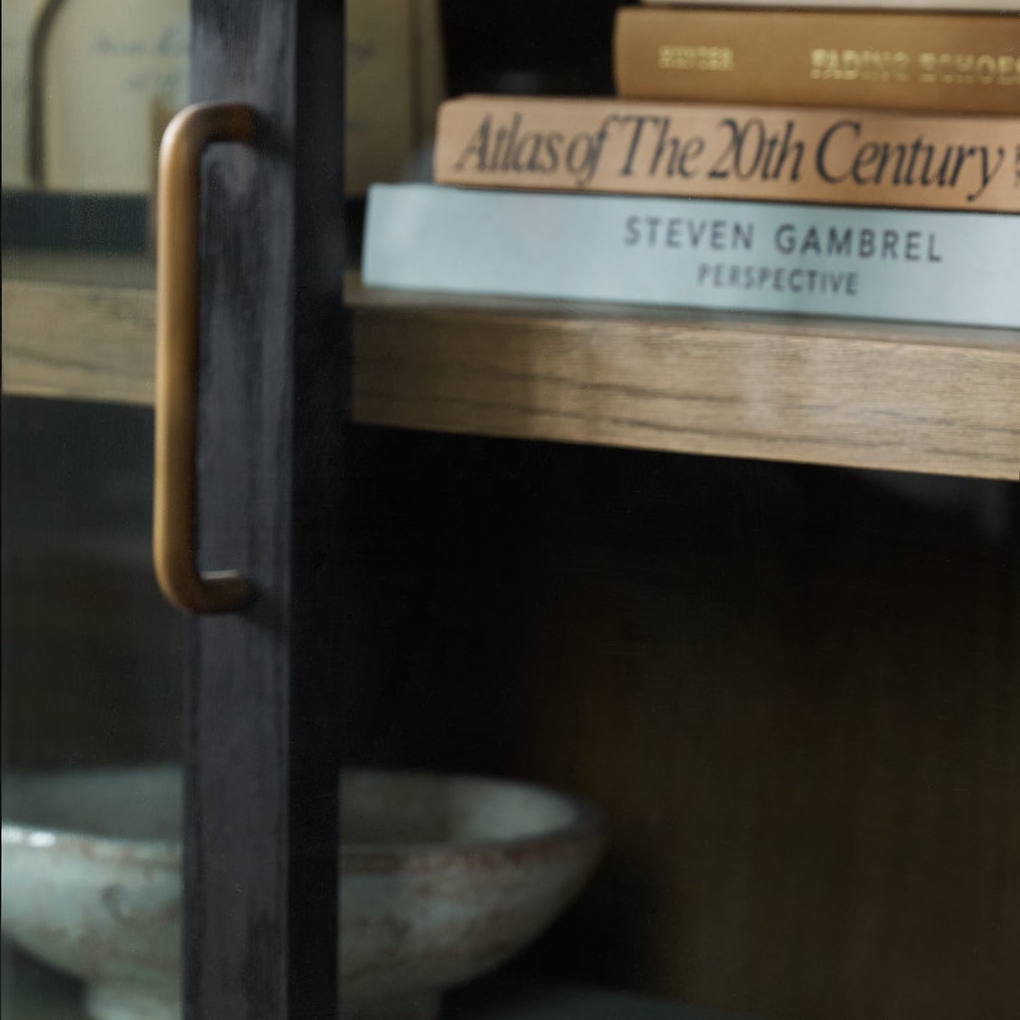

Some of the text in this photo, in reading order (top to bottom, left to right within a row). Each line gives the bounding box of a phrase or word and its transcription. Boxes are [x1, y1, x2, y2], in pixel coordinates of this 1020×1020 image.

[809, 48, 910, 81] FADING
[453, 111, 566, 173] Atlas
[564, 113, 622, 189] of
[618, 114, 706, 180] The
[707, 117, 804, 182] 20th
[815, 118, 1005, 202] Century
[623, 215, 943, 263] STEVEN GAMBREL
[696, 263, 861, 297] PERSPECTIVE
